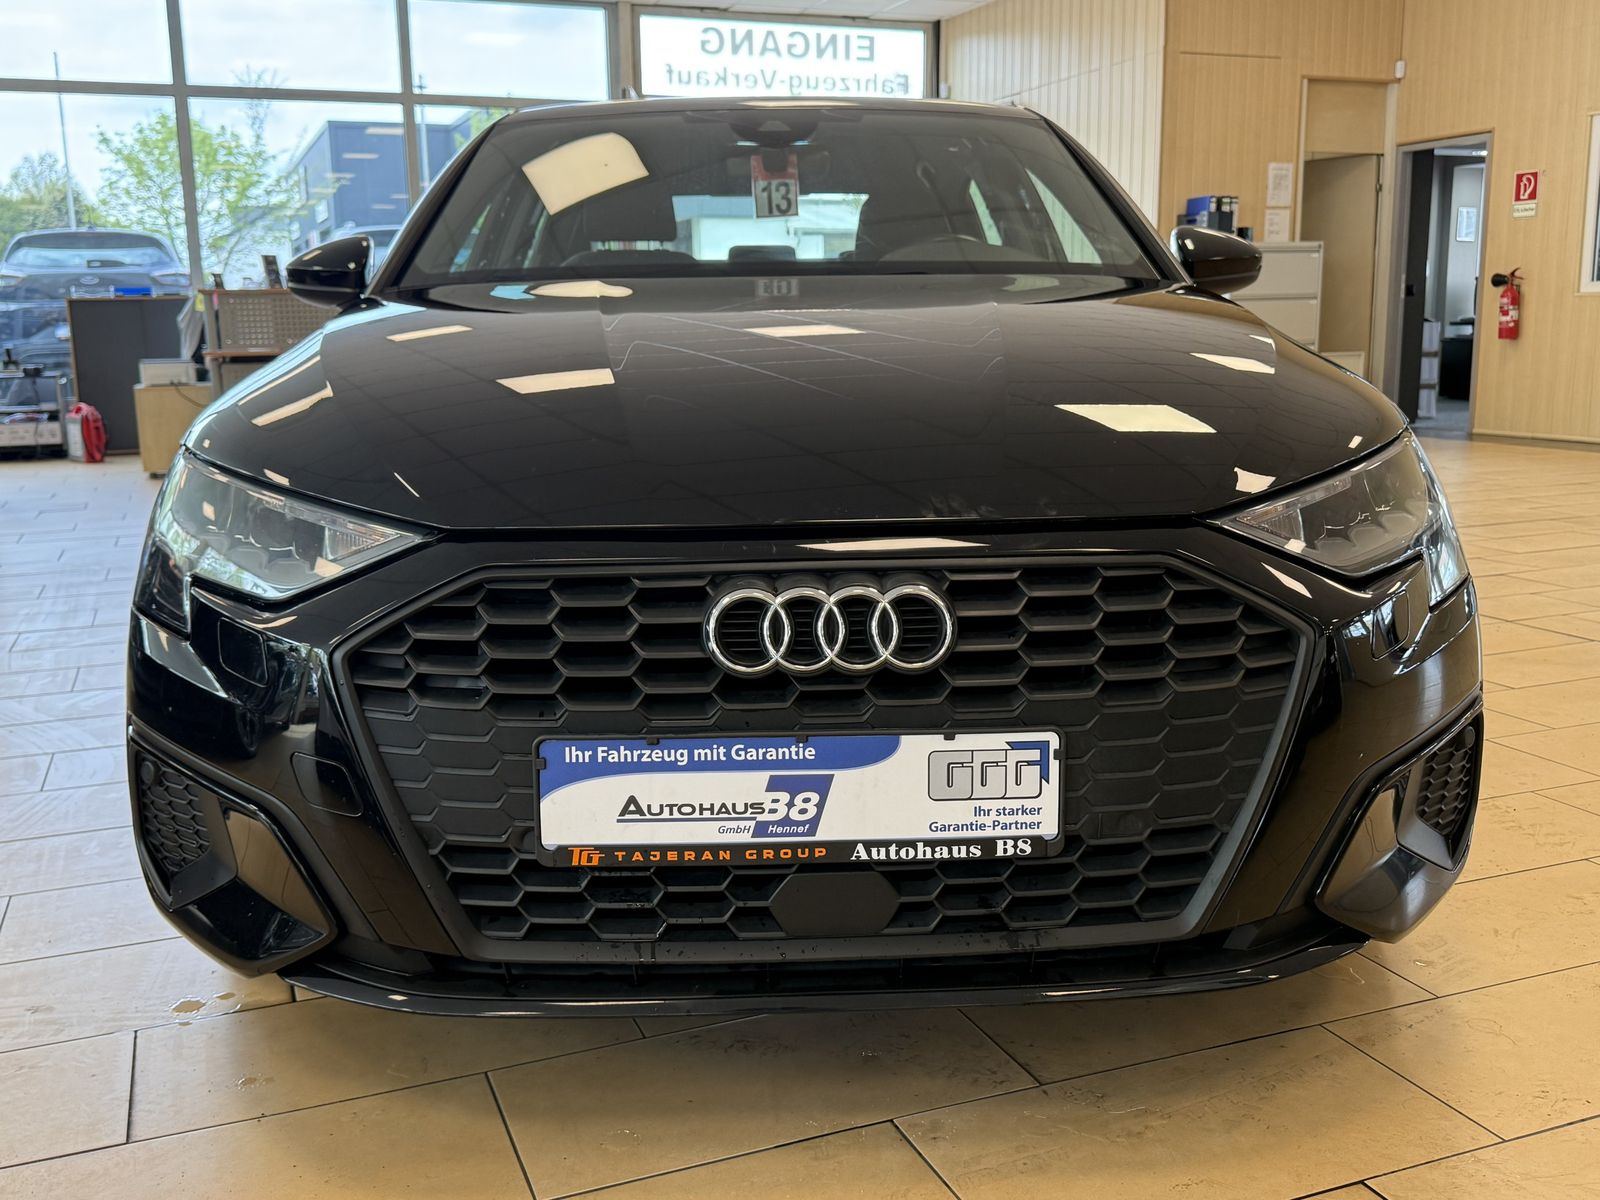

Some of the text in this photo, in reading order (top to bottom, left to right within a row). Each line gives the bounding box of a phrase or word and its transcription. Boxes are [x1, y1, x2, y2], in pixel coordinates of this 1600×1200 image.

[761, 181, 792, 215] 13
[564, 743, 816, 766] Ihr Fahrzeug mit Garantie
[759, 791, 821, 821] B8
[973, 804, 1043, 817] Ihr starker
[717, 823, 810, 835] GmbH Hennef
[928, 819, 1042, 833] Garantie-Partner
[614, 850, 731, 862] TAJERAN
[745, 847, 827, 861] GROUP
[850, 838, 1032, 861] Autohaus B8
